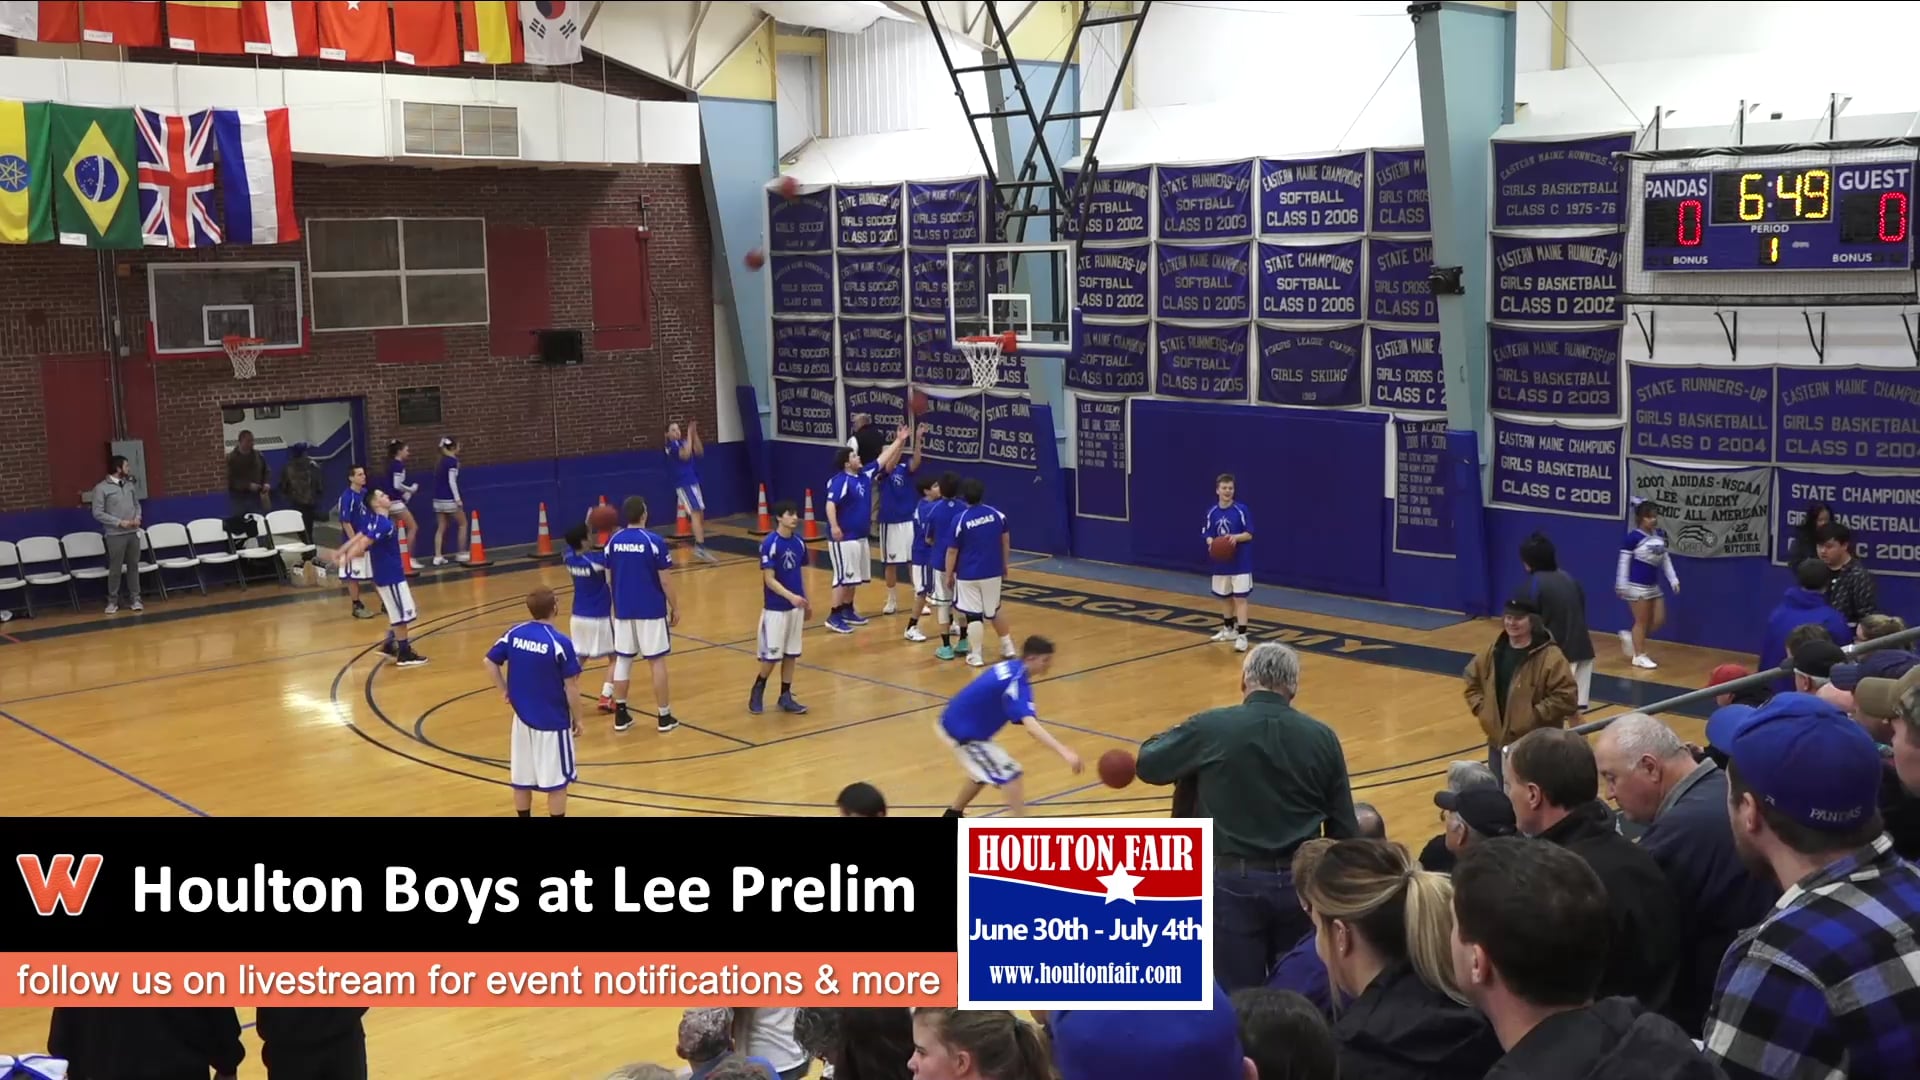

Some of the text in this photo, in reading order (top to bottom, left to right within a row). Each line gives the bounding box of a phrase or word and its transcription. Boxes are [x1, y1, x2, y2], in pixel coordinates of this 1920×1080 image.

[1539, 151, 1565, 162] MAINE
[1262, 165, 1362, 192] EASTERN MAINE CHAMPIONS
[1839, 169, 1909, 190] GUEST
[1161, 177, 1188, 198] STATE
[1503, 182, 1619, 196] GIRLS BASKETBALL
[1645, 178, 1708, 198] PANDAS
[1740, 170, 1829, 221] 6:49
[1176, 199, 1235, 212] SOFTBALL
[1280, 190, 1344, 205] SOFTBALL
[1507, 204, 1544, 216] CLASS
[1551, 204, 1559, 215] C
[1878, 192, 1907, 242] 0
[866, 215, 896, 226] SOCCER
[1165, 215, 1247, 231] CLASS D 2003
[1267, 211, 1358, 226] CLASS D 2006
[1678, 200, 1702, 246] 0
[870, 230, 876, 242] D
[1751, 225, 1789, 233] PERIOD
[1497, 245, 1534, 271] EASTERN
[1536, 244, 1563, 261] MAINE
[1770, 237, 1779, 262] 1
[1265, 253, 1354, 274] STATE CHAMPIONS
[1673, 256, 1708, 264] BONUS
[1832, 253, 1872, 263] BONUS
[1079, 277, 1133, 289] SOFTBALL
[1175, 277, 1232, 289] SOFTBALL
[1277, 277, 1341, 290] SOFTBALL
[1501, 275, 1616, 291] GIRLS BASKETBALL
[1162, 296, 1246, 310] CLASS D 2005
[1264, 297, 1355, 312] CLASS D 2006
[1501, 296, 1615, 314] CLASS D 2002
[1160, 337, 1186, 354] STATE
[1411, 338, 1434, 354] MAINE
[1533, 341, 1559, 356] MAINE
[1172, 357, 1231, 370] SOFTBALL
[1162, 373, 1244, 392] CLASS D 2005
[1271, 368, 1348, 382] GIRLS SKIING
[1405, 370, 1433, 383] CROSS
[1497, 368, 1611, 385] GIRLS BASKETBALL
[1377, 385, 1436, 404] CLASS C
[1498, 386, 1610, 404] CLASS D 2003
[1636, 378, 1768, 402] STATE RUNNERS-UP
[1782, 380, 1920, 406] EASTERN MAINE CHAMPIO
[850, 391, 903, 409] STATE CHAMPIONS
[803, 409, 831, 418] SOCCER
[874, 415, 905, 425] SOCCER
[1636, 410, 1768, 430] GIRLS BASKETBALL
[781, 420, 804, 432] CLASS
[945, 427, 977, 437] SOCCER
[1783, 415, 1920, 434] GIRLS BASKETBAL
[1499, 431, 1615, 454] EASTERN MAINE CHAMPIONS
[1638, 433, 1766, 453] CLASS D 2004
[1785, 439, 1848, 456] CLASS
[1856, 442, 1868, 456] D
[1501, 456, 1612, 480] GIRLS BASKETBALL
[1637, 476, 1664, 488] 2007
[1502, 480, 1611, 504] CLASS C 2008
[1656, 490, 1739, 506] LEE ACADEMY
[1792, 484, 1836, 501] STATE
[1685, 505, 1767, 521] ALL AMERICAN
[966, 514, 994, 529] PANDAS
[1834, 514, 1920, 532] BASKETBAL
[613, 543, 645, 553] PANDAS
[1856, 543, 1868, 558] C
[512, 637, 548, 654] PANDAS
